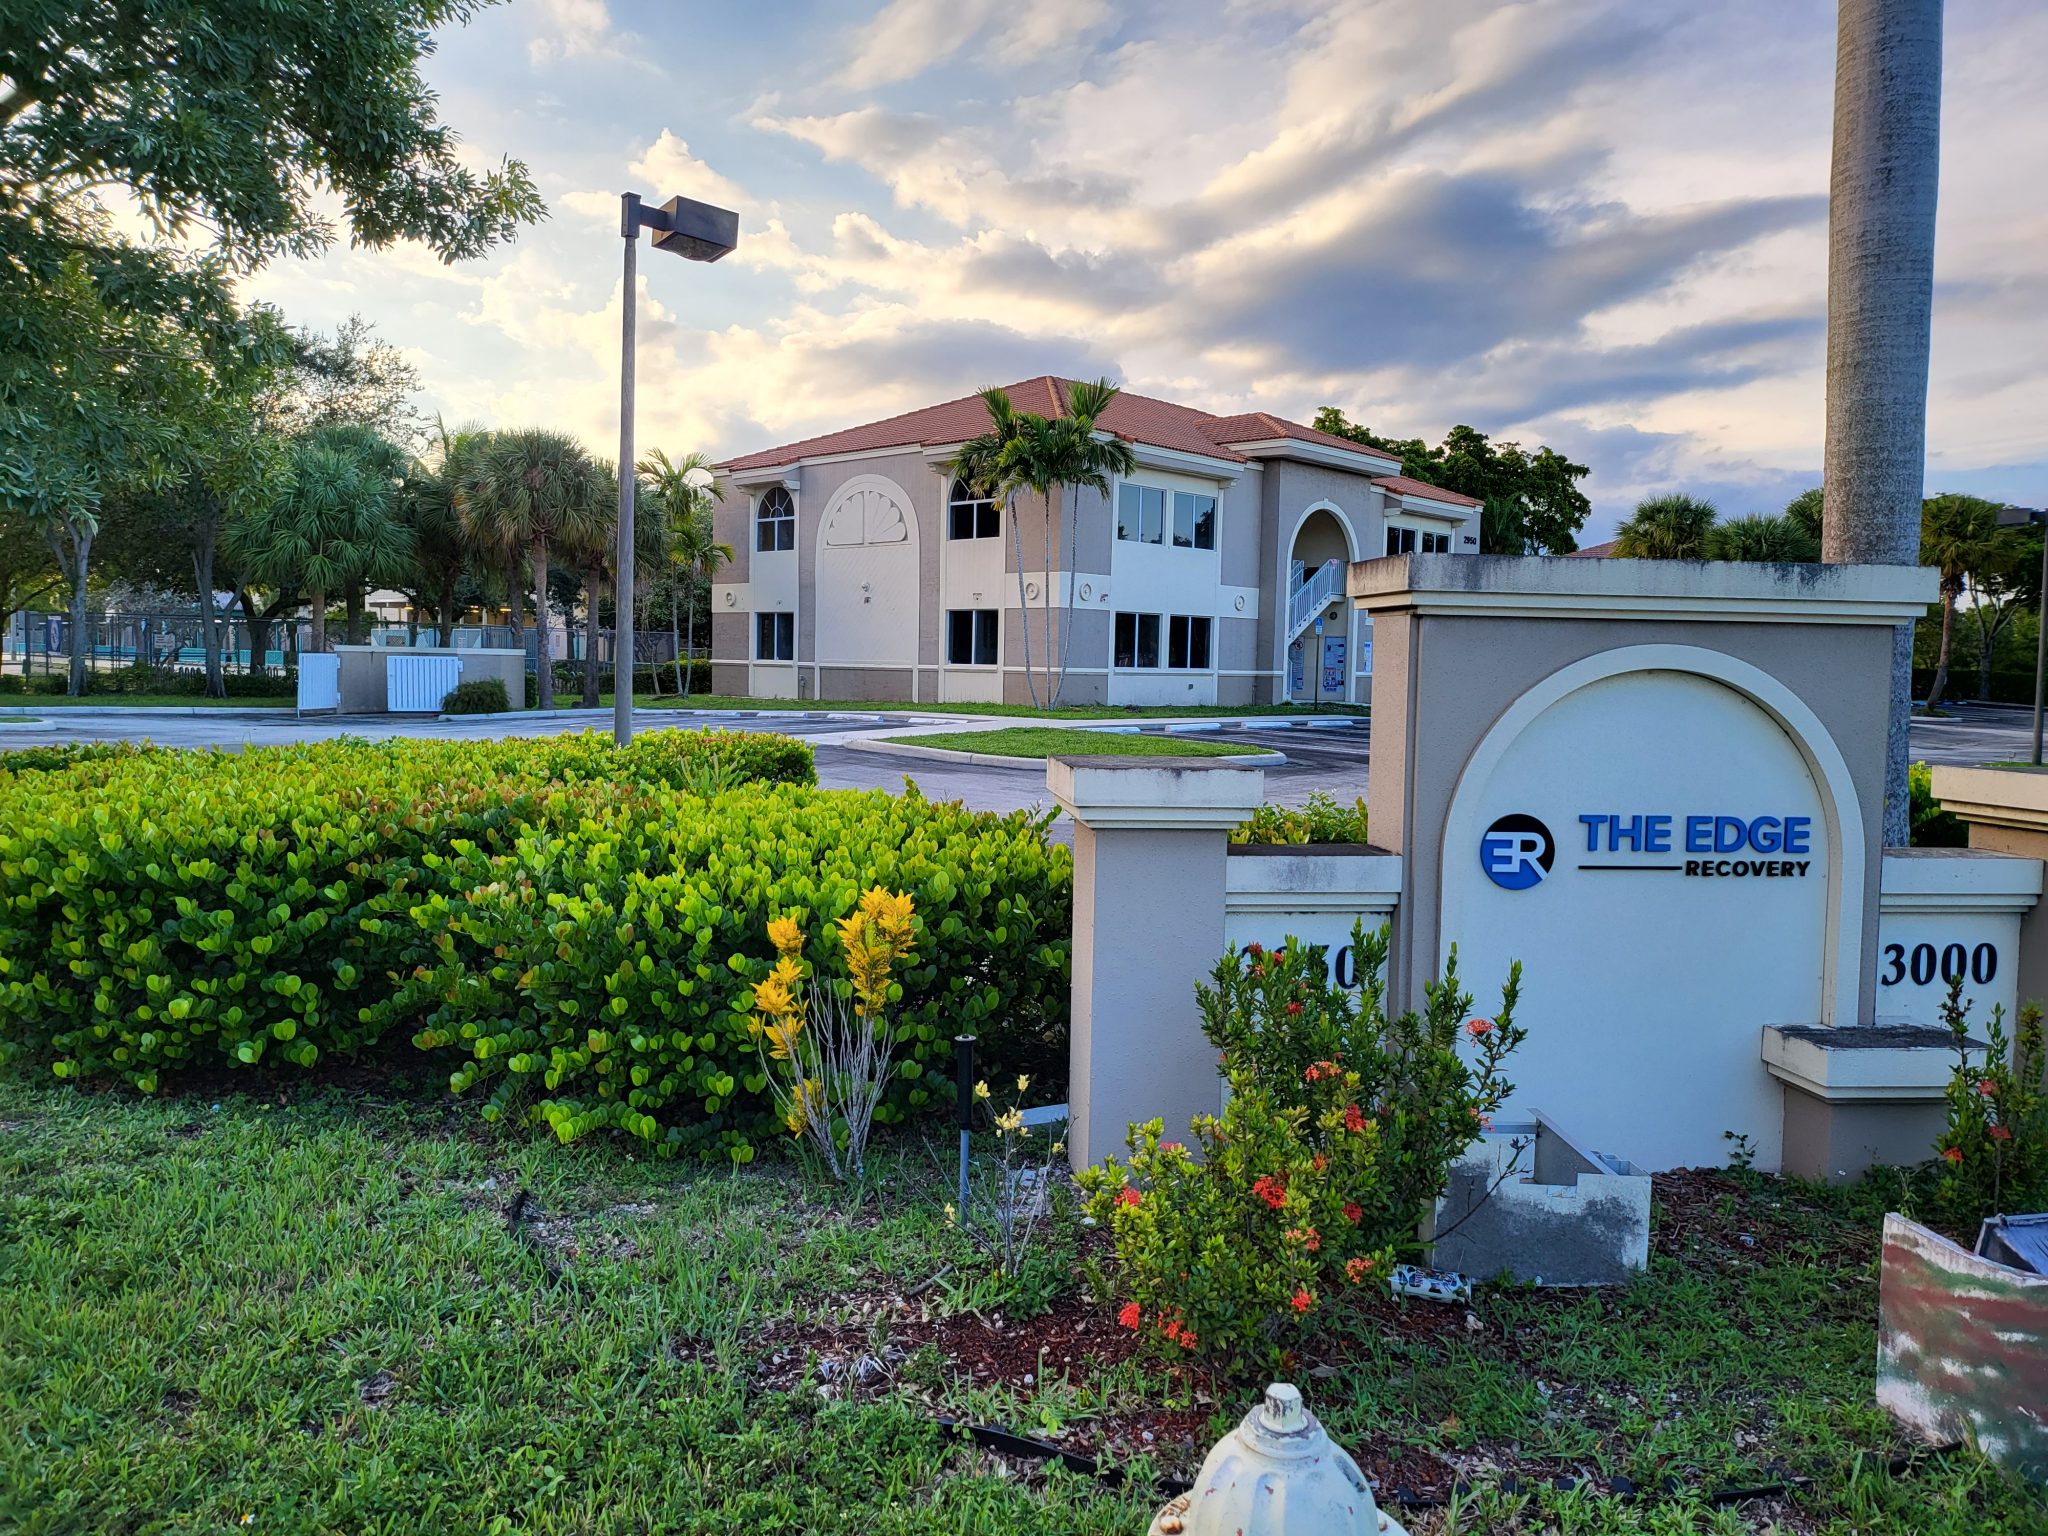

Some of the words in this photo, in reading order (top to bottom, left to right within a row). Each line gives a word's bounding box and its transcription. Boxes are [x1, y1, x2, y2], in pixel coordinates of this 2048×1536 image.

[1463, 535, 1477, 545] 2950
[1579, 815, 1672, 852] THE
[1685, 815, 1811, 853] EDGE
[1485, 831, 1548, 880] ER
[1685, 860, 1811, 877] RECOVERY
[1881, 942, 1998, 986] 3000
